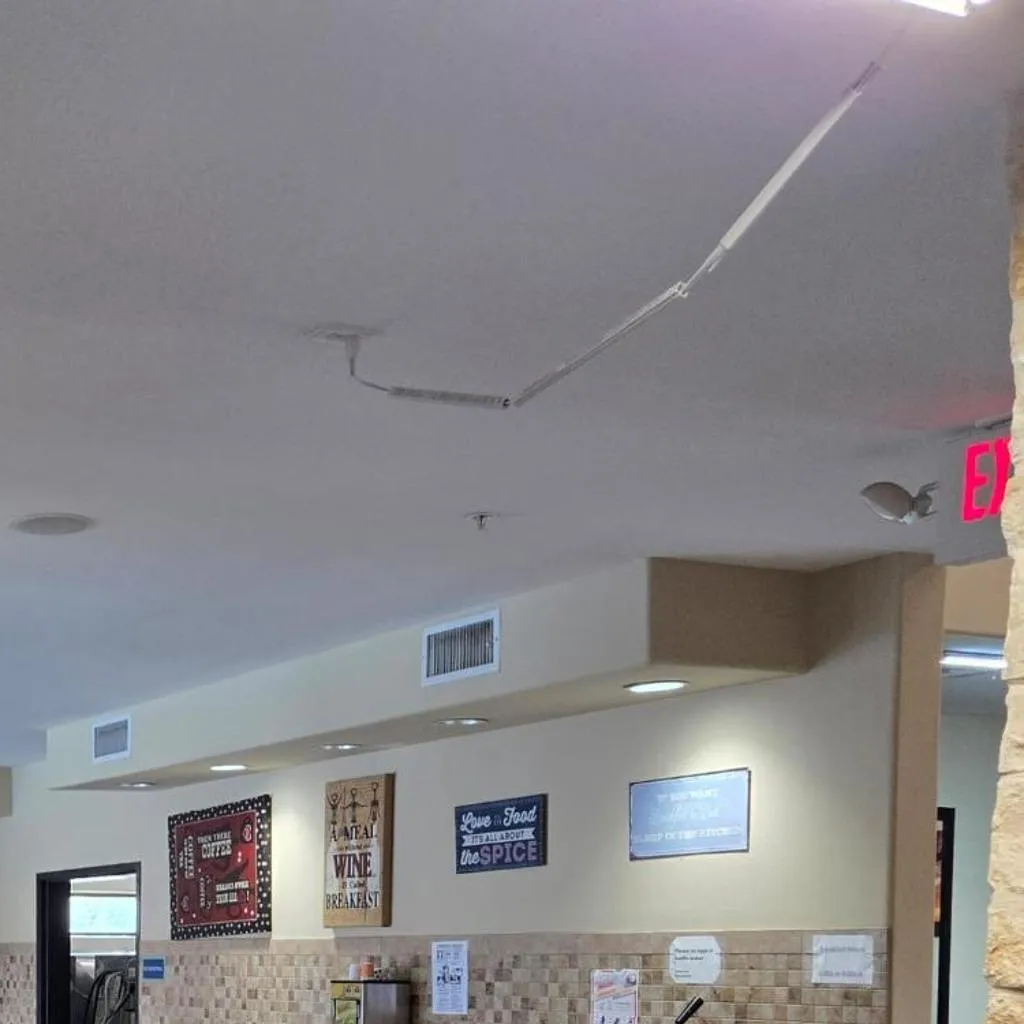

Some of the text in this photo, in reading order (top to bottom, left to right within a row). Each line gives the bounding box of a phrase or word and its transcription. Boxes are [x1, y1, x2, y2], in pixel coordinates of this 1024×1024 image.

[460, 812, 492, 834] Love
[503, 805, 537, 827] Food
[202, 839, 232, 858] COFFEE
[460, 841, 538, 866] the SPICE
[332, 852, 372, 878] WINE
[326, 891, 381, 910] BREAKFAST
